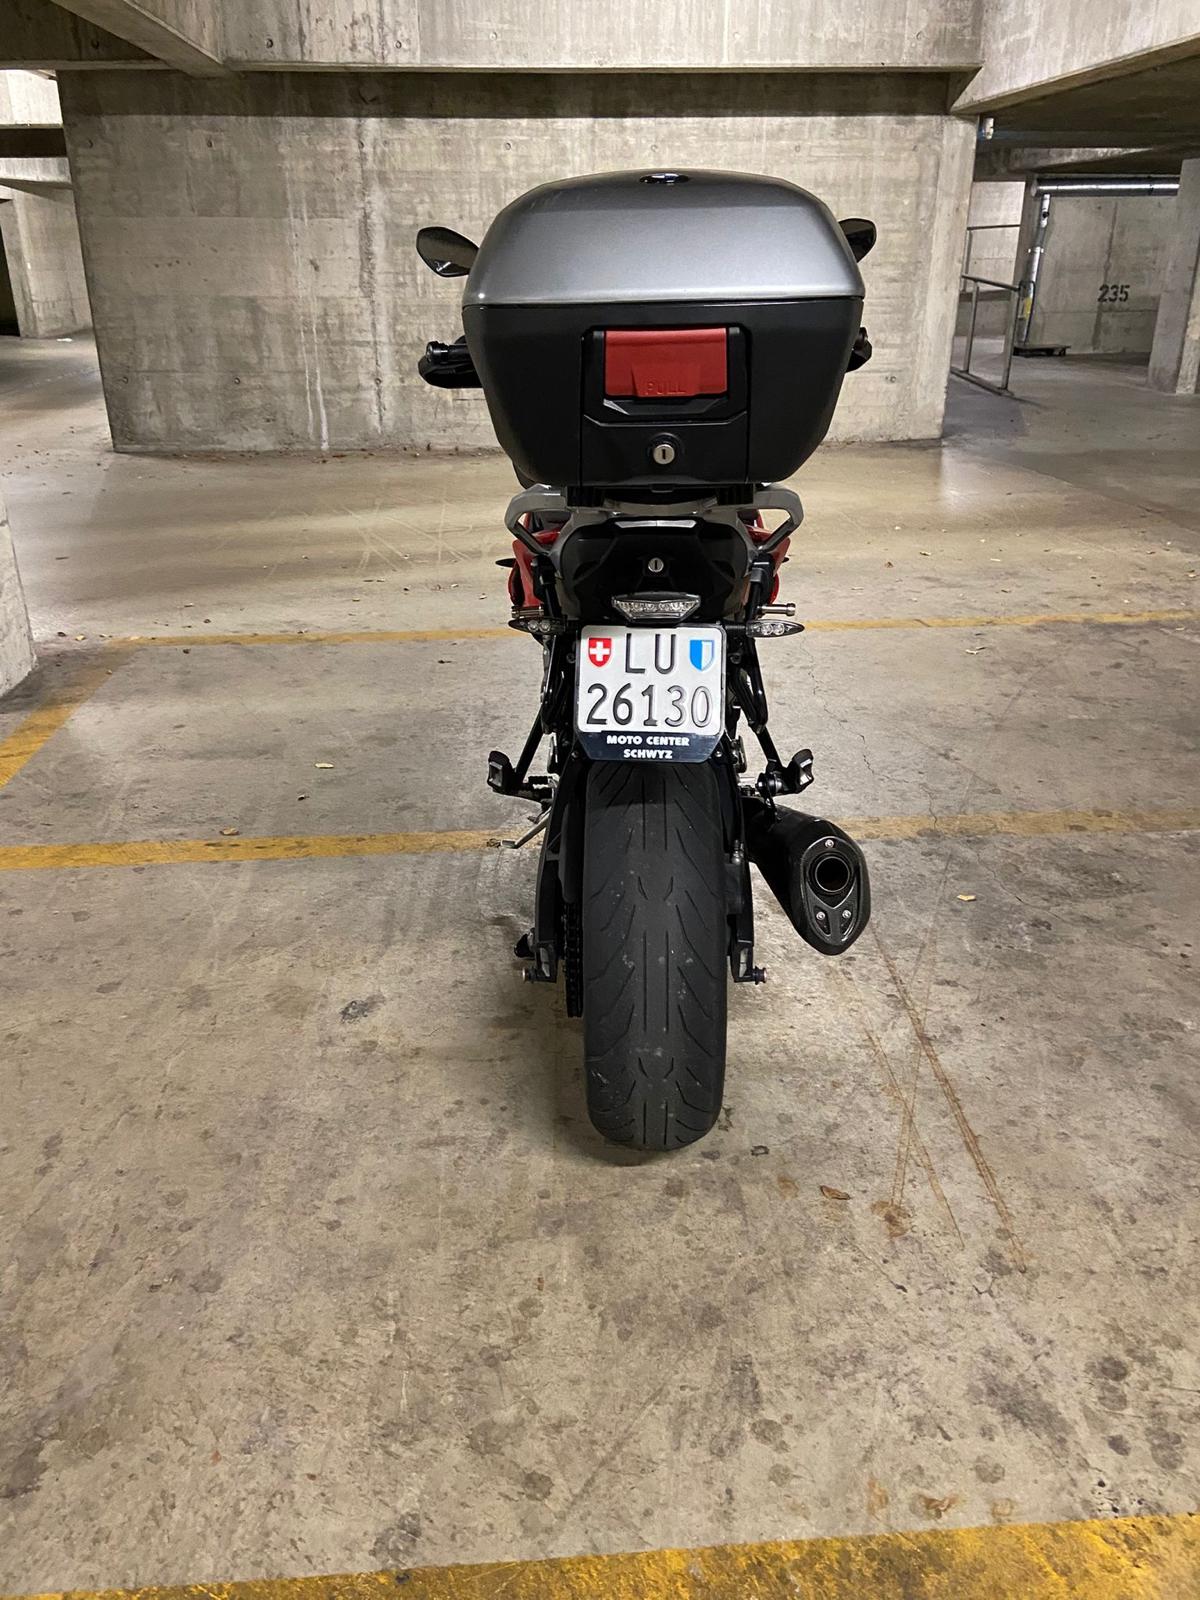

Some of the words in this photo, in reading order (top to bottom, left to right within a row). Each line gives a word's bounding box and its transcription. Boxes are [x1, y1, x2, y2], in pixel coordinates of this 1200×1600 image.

[1097, 284, 1130, 302] 235
[645, 381, 686, 395] PULL
[625, 633, 676, 674] LU
[586, 683, 712, 728] 26130
[606, 735, 642, 745] MOTO
[646, 736, 690, 746] CENTER
[623, 749, 673, 759] SCHWYZ
